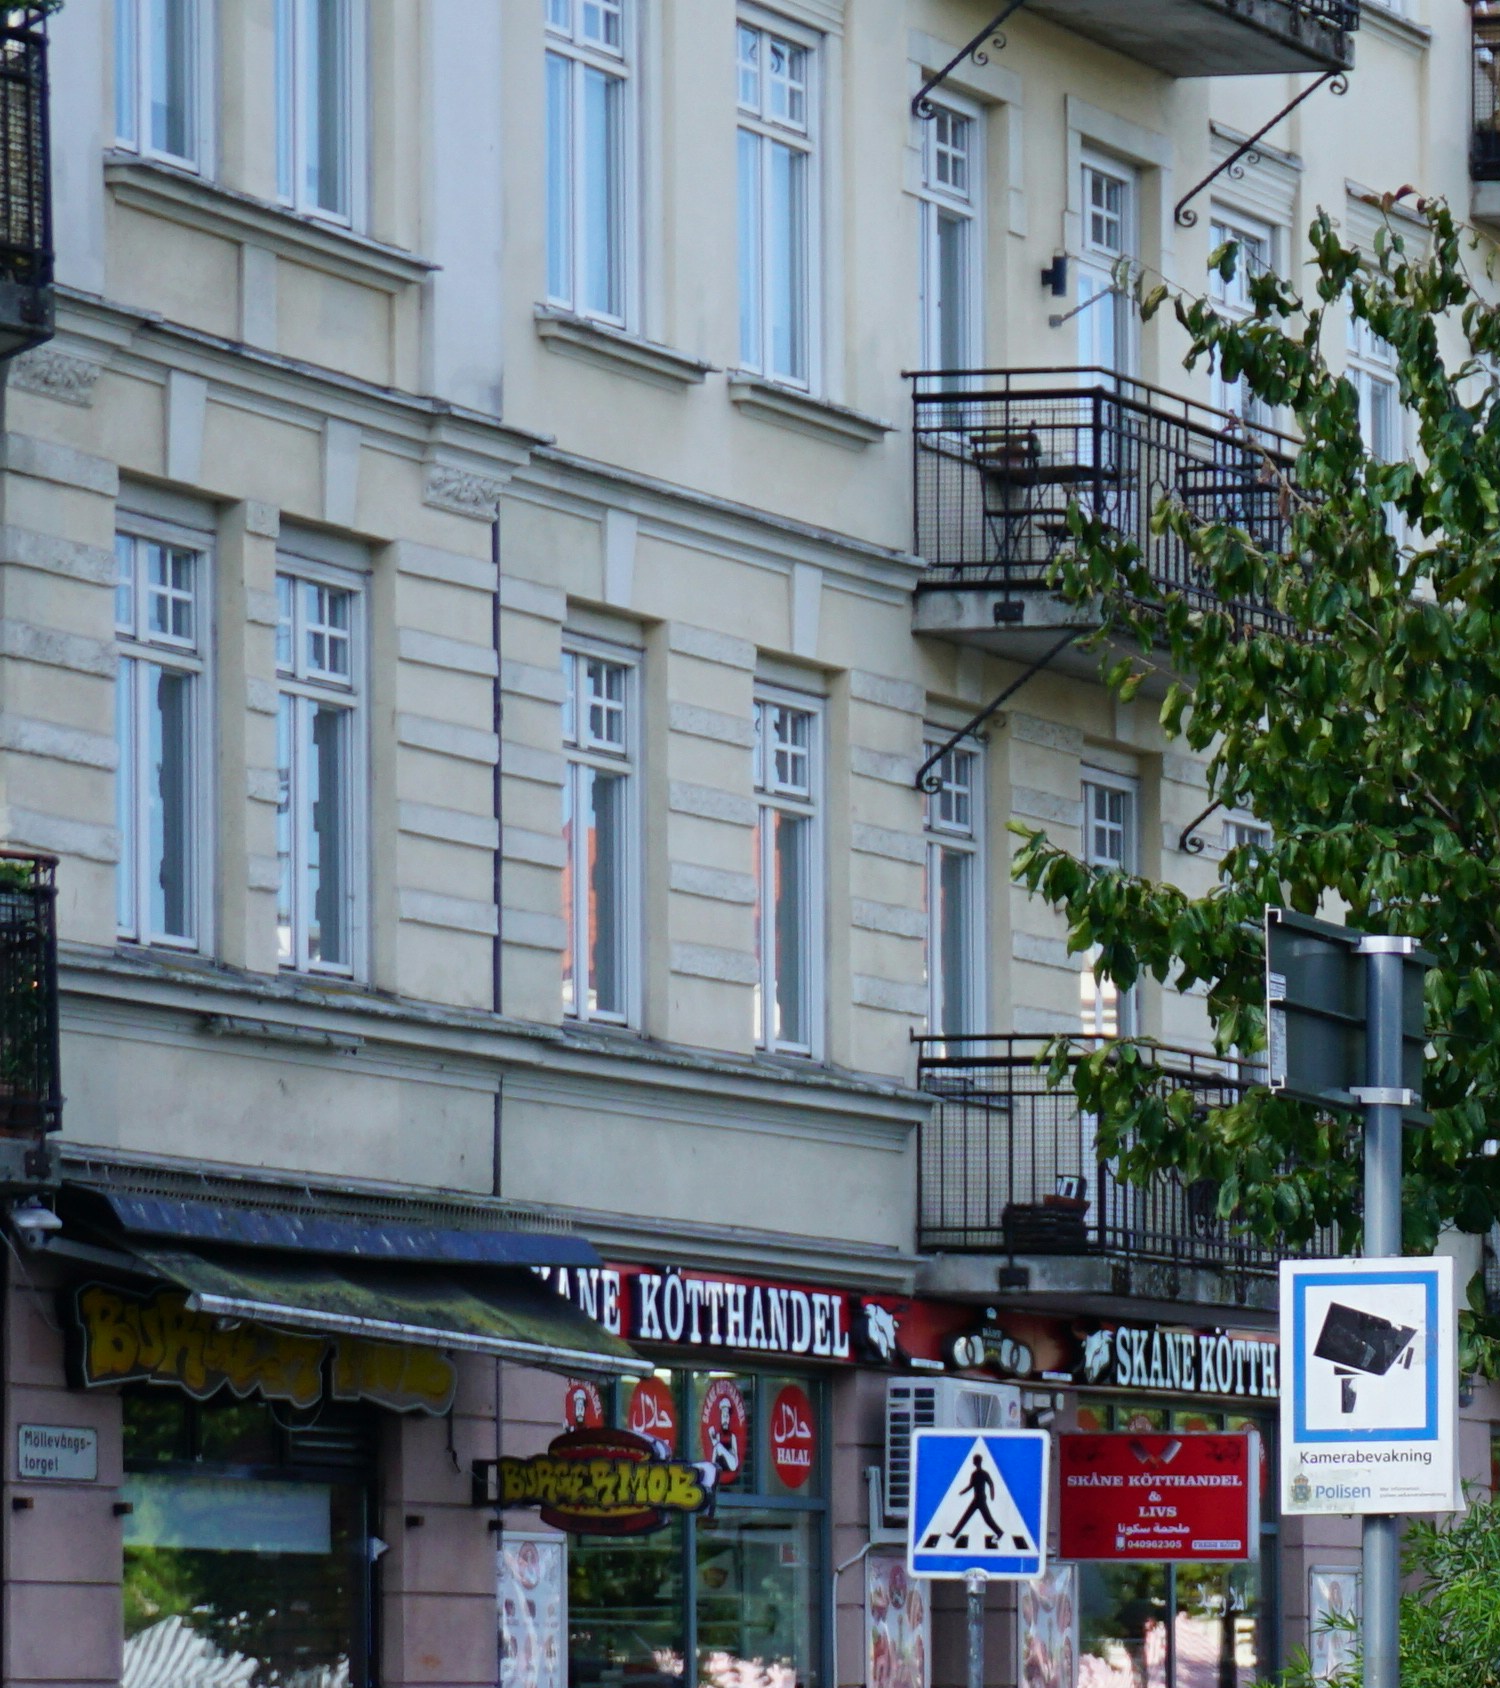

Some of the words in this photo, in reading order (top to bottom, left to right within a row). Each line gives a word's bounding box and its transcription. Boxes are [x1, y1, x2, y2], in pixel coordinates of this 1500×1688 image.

[639, 1265, 849, 1358] KÖTTHANDEL
[1116, 1323, 1195, 1391] SKÅNE
[1199, 1327, 1280, 1397] KÖTTH
[774, 1402, 812, 1443] حلال
[24, 1430, 92, 1454] Möllevångs-
[24, 1454, 59, 1475] torget
[777, 1447, 811, 1466] HALAL
[1300, 1449, 1432, 1465] Kamerabevakning
[1067, 1472, 1124, 1487] SKÅNE
[1128, 1473, 1243, 1487] KÖTTHANDEL
[1148, 1491, 1162, 1502] &
[1315, 1484, 1371, 1499] Polisen
[1138, 1506, 1178, 1518] LIVS
